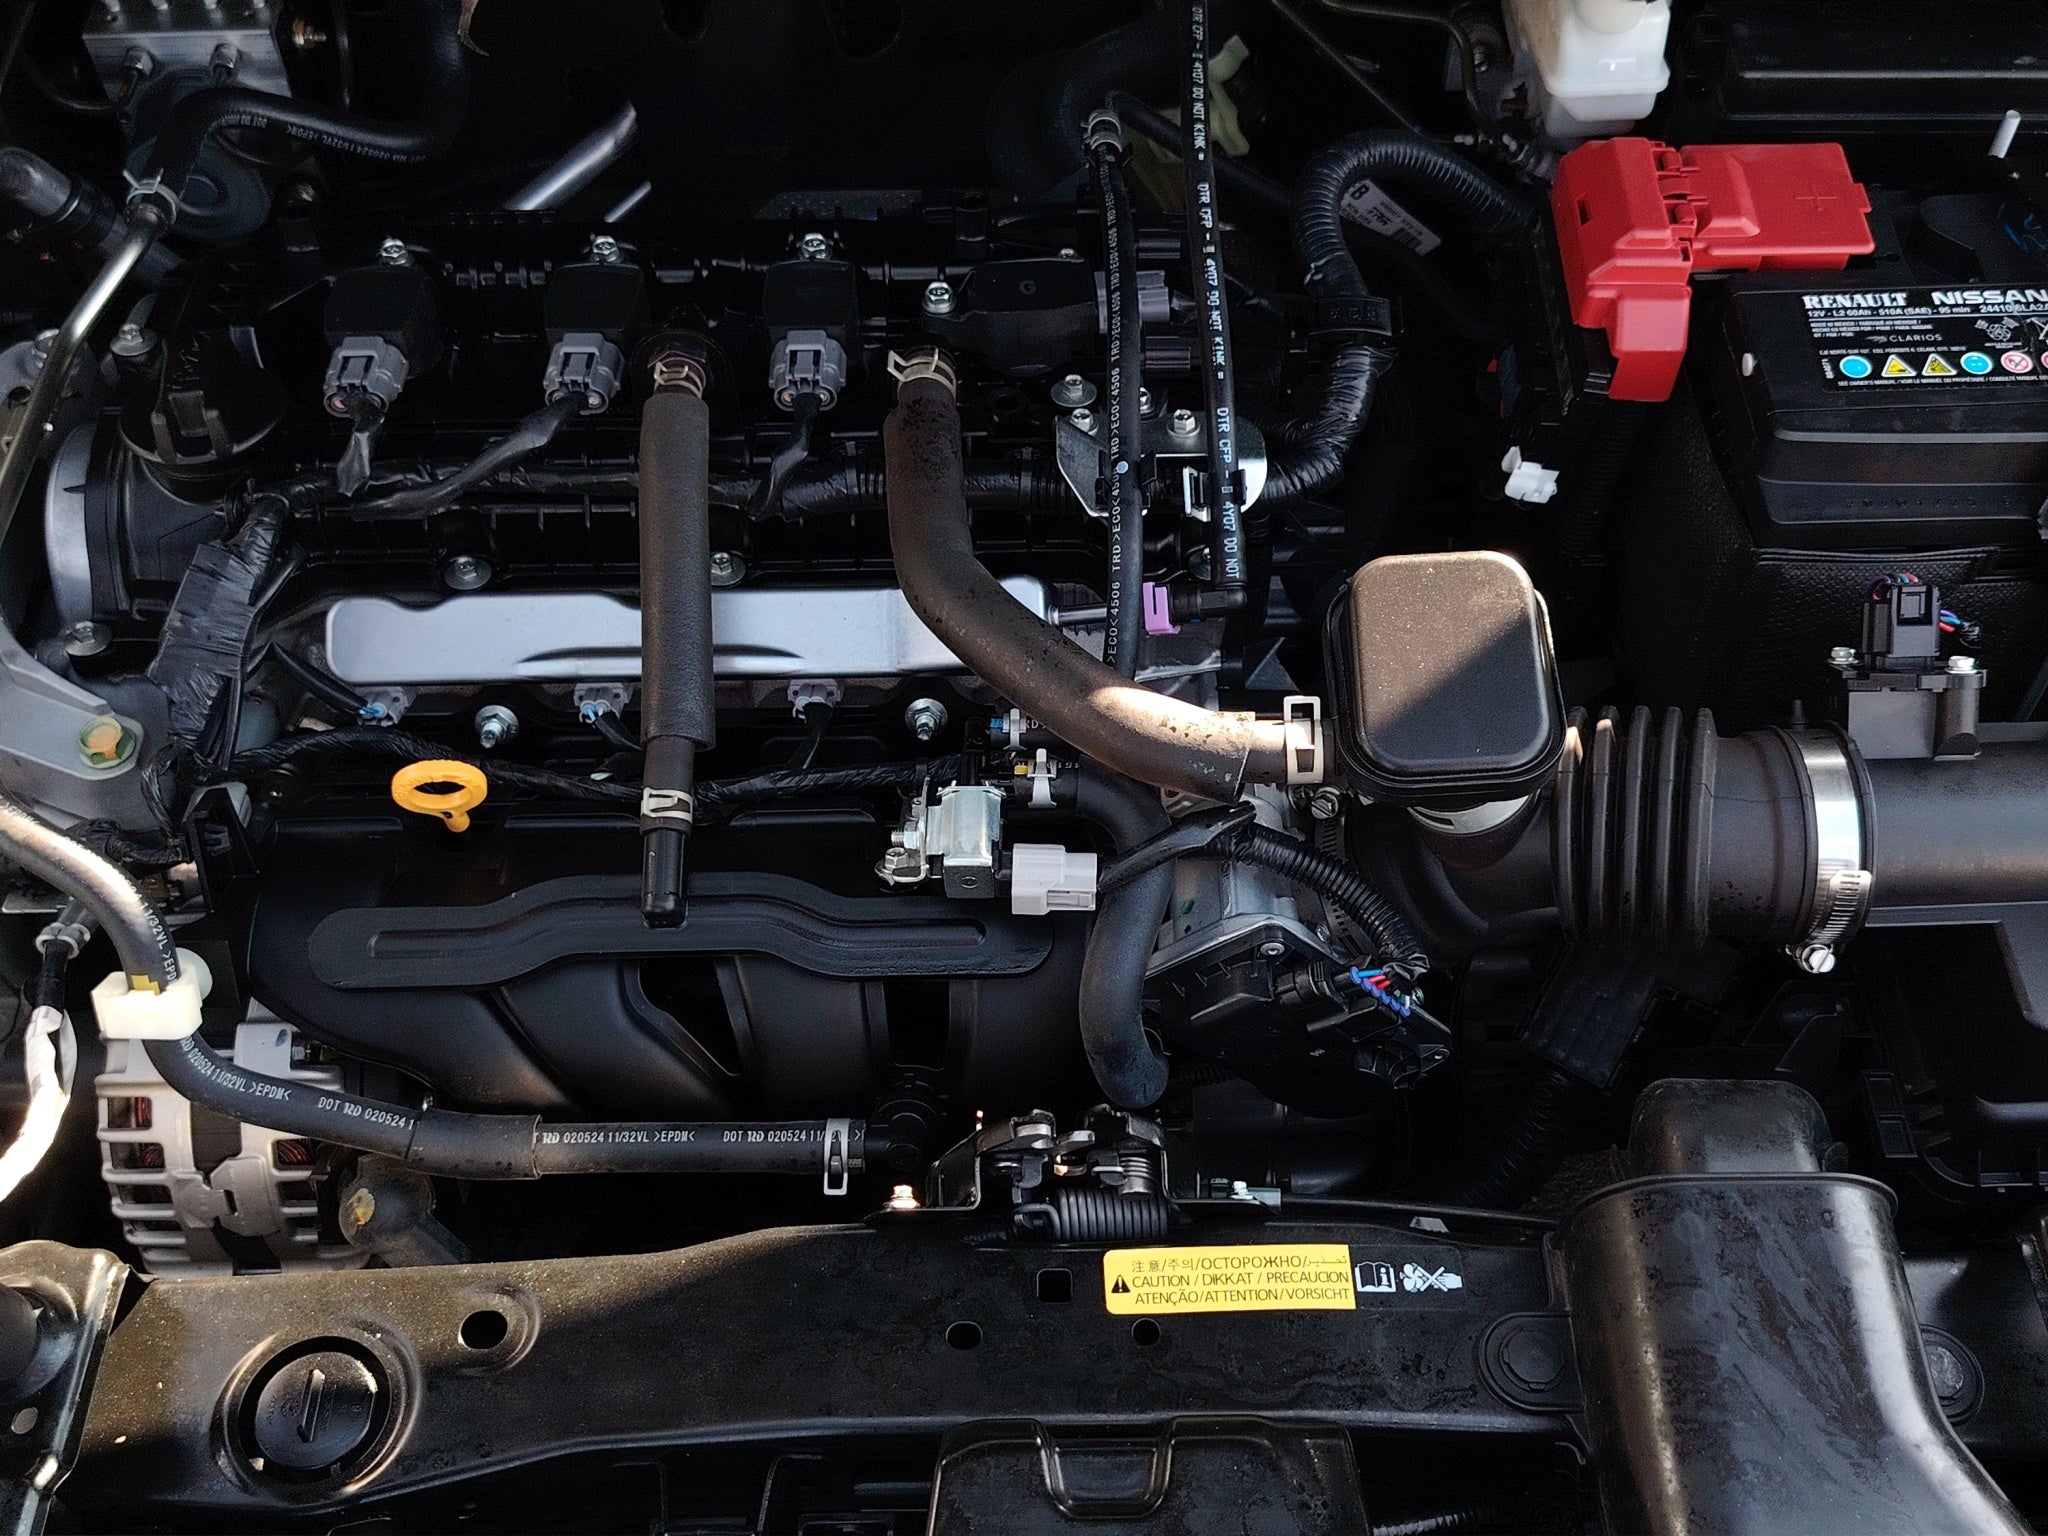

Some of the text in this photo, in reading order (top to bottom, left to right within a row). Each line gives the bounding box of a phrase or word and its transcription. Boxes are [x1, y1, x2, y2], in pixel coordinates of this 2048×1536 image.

[1193, 102, 1205, 120] NOT
[1801, 289, 2048, 310] RENAULT NISSAN
[1807, 310, 1826, 318] 12V
[1889, 334, 1942, 342] CLARIOS
[1217, 407, 1231, 433] DTR
[1219, 439, 1232, 463] CFP
[1222, 501, 1236, 531] 4Y07
[1223, 537, 1238, 553] DO
[1225, 558, 1240, 579] NOT
[187, 1047, 216, 1077] 020524
[318, 1096, 342, 1111] DOT
[365, 1108, 407, 1129] 020524
[563, 1131, 605, 1144] 020524
[723, 1130, 744, 1143] DOT
[767, 1130, 806, 1142] 020524
[1132, 1275, 1190, 1288] CAUTION
[1202, 1272, 1254, 1286] DIKKAT
[1266, 1271, 1349, 1284] PRECAUCION
